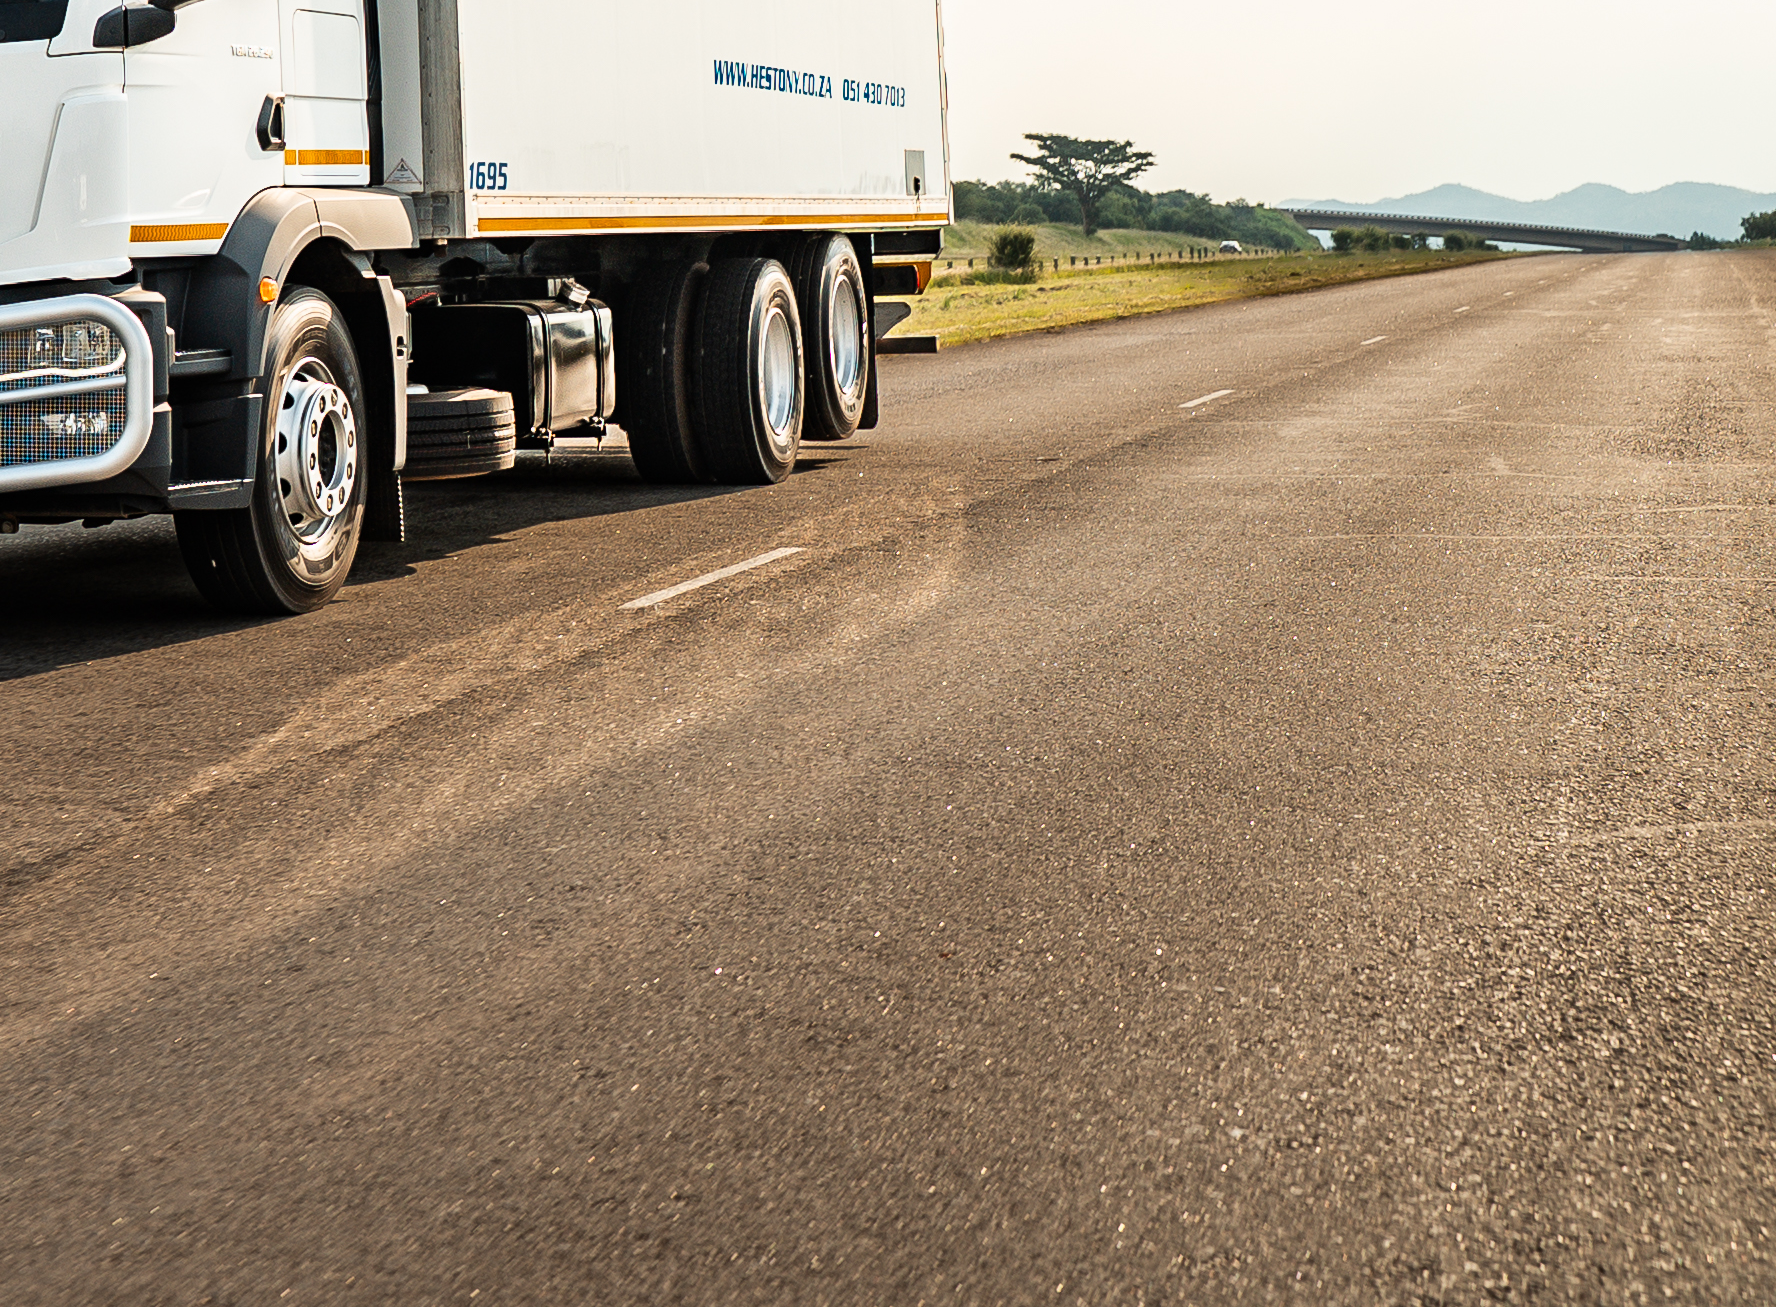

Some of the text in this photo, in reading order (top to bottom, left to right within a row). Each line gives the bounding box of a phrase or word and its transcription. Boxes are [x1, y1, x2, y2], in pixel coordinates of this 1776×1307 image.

[713, 59, 906, 107] WWW.HESTONY.CO.ZA 051 430 7013
[469, 162, 508, 190] 1695
